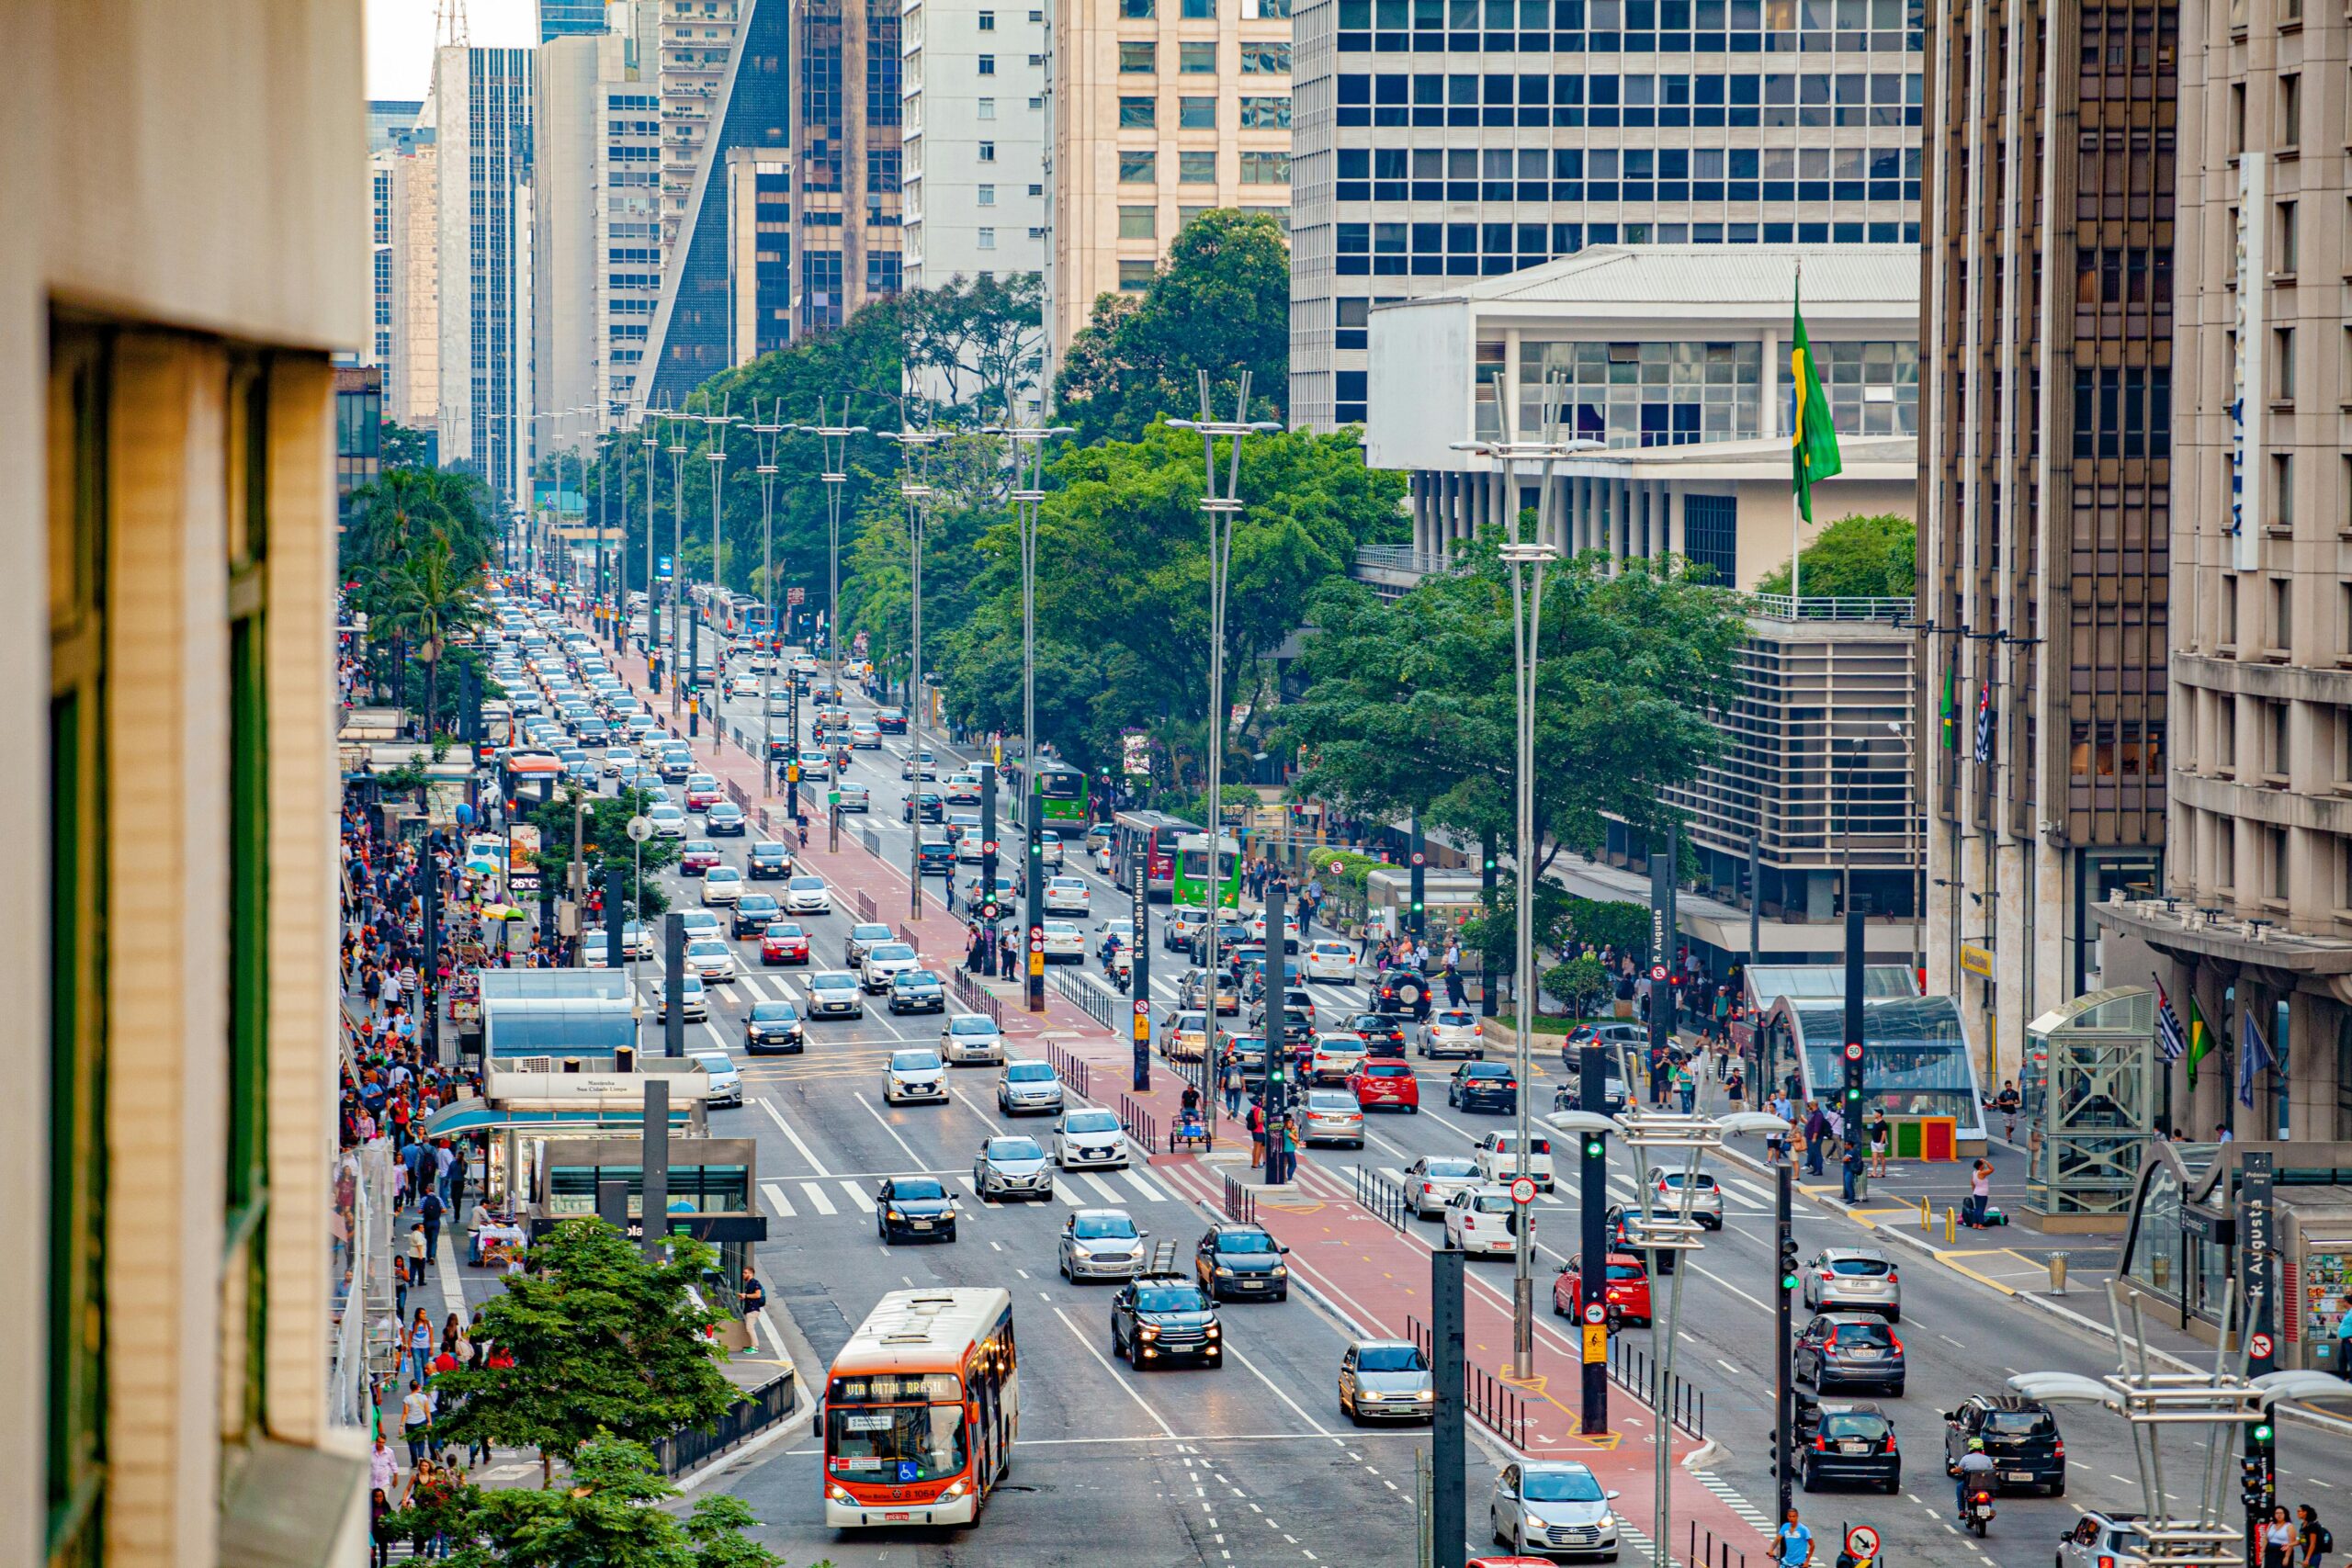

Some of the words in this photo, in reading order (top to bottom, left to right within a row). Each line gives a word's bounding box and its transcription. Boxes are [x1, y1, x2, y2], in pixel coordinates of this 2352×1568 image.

[1135, 866, 1144, 903] Manuel
[1135, 905, 1144, 931] João
[1653, 909, 1664, 951] Augusta
[1135, 932, 1144, 947] Pe.
[1135, 949, 1144, 959] R.
[1653, 953, 1662, 963] R.
[1849, 1047, 1860, 1055] 50
[2248, 1199, 2267, 1276] Augusta
[2248, 1281, 2264, 1297] R.
[846, 1383, 865, 1396] VIA
[871, 1382, 900, 1395] VITAL
[906, 1381, 944, 1393] BRASIL
[914, 1489, 935, 1498] 1064
